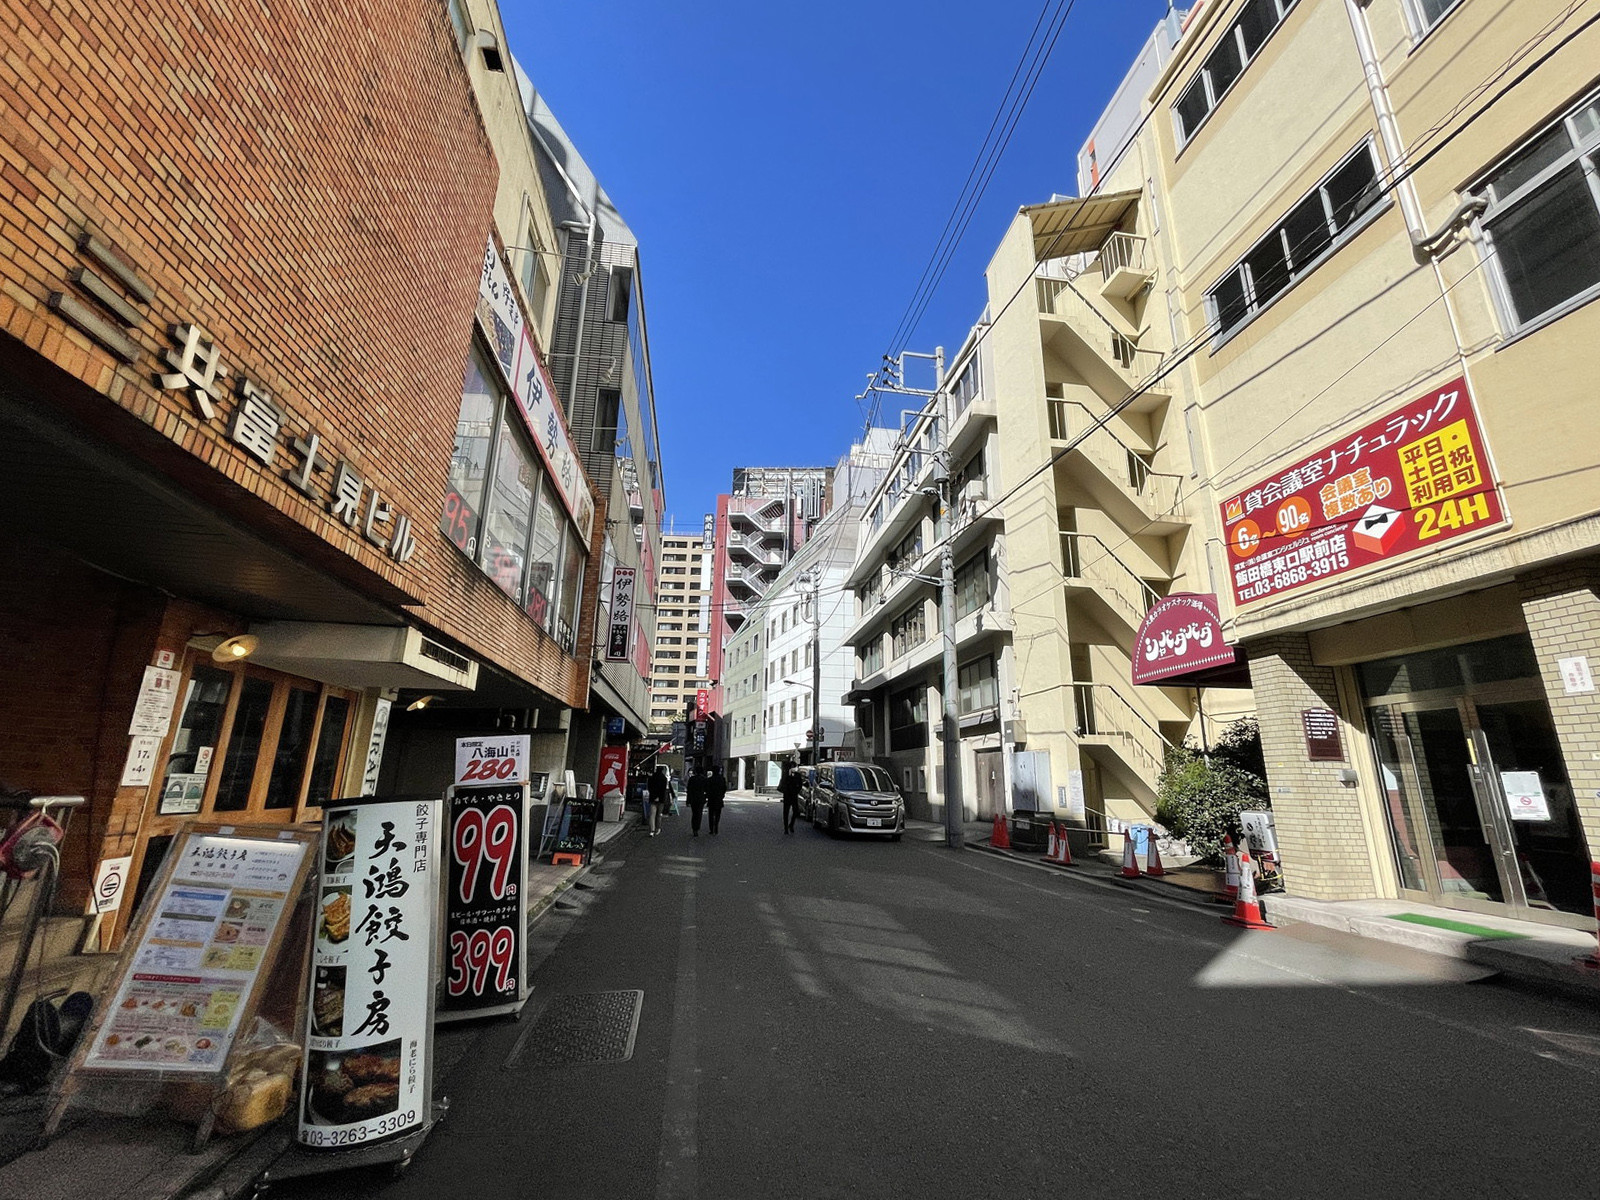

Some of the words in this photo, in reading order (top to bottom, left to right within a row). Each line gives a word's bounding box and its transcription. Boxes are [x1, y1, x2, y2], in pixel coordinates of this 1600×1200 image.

[47, 232, 416, 563] 三共富士見ビル
[526, 364, 572, 491] 伊勢路
[1244, 390, 1458, 514] 貸会議室ナチュラック
[1321, 468, 1371, 503] 会議室
[1323, 477, 1391, 520] 複数あり
[1414, 493, 1490, 540] 24H
[1236, 534, 1346, 587] 飯田橋東口駅前店
[613, 578, 632, 621] 伊勢路
[472, 746, 508, 759] 八海山
[413, 804, 429, 873] 餃子専門店
[351, 821, 410, 1038] 天鴻餃子房
[310, 1110, 416, 1146] 03-3263-3309
